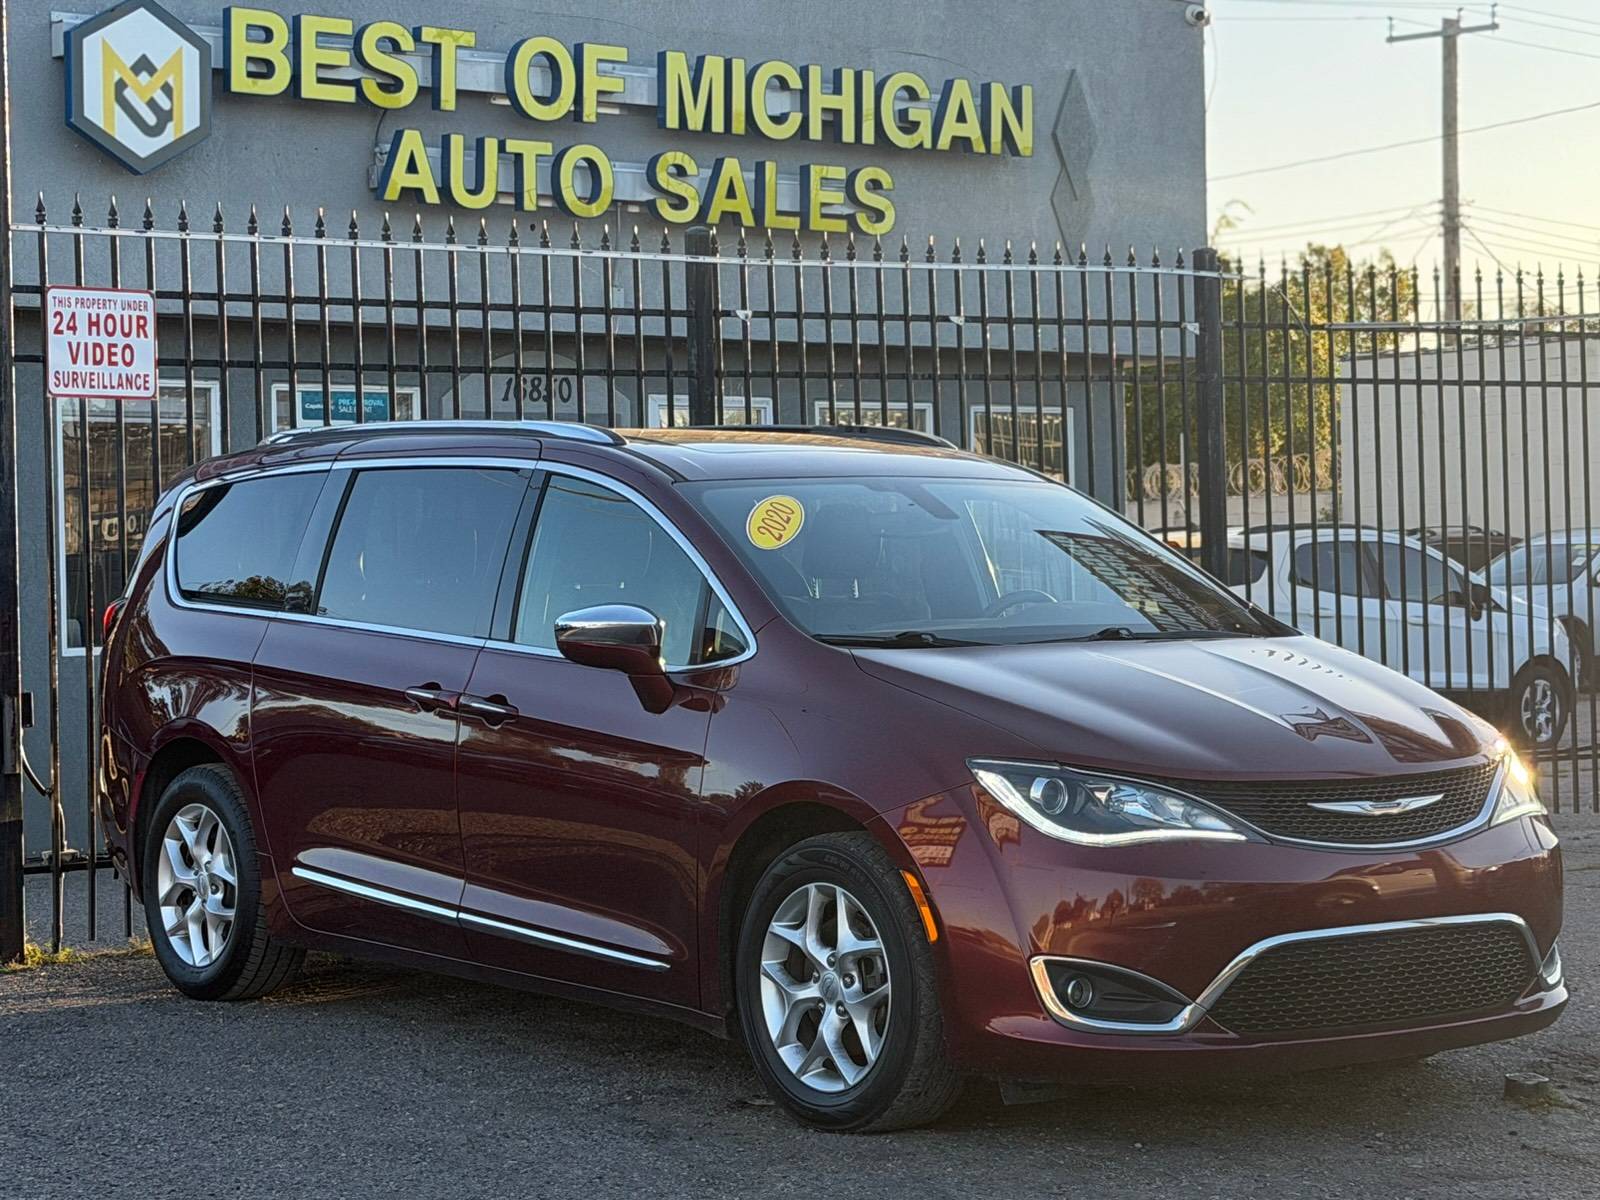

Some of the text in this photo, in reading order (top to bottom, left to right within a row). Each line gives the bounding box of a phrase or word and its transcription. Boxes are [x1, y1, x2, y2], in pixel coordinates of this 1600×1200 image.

[225, 6, 1034, 157] BEST OF MICHIGAN
[379, 129, 896, 236] AUTO SALES
[52, 296, 149, 312] THIS PROPERTY UNDER
[53, 310, 149, 339] 24 HOUR
[67, 341, 135, 368] VIDEO
[53, 370, 150, 391] SURVEILLANCE
[757, 502, 795, 542] 2020
